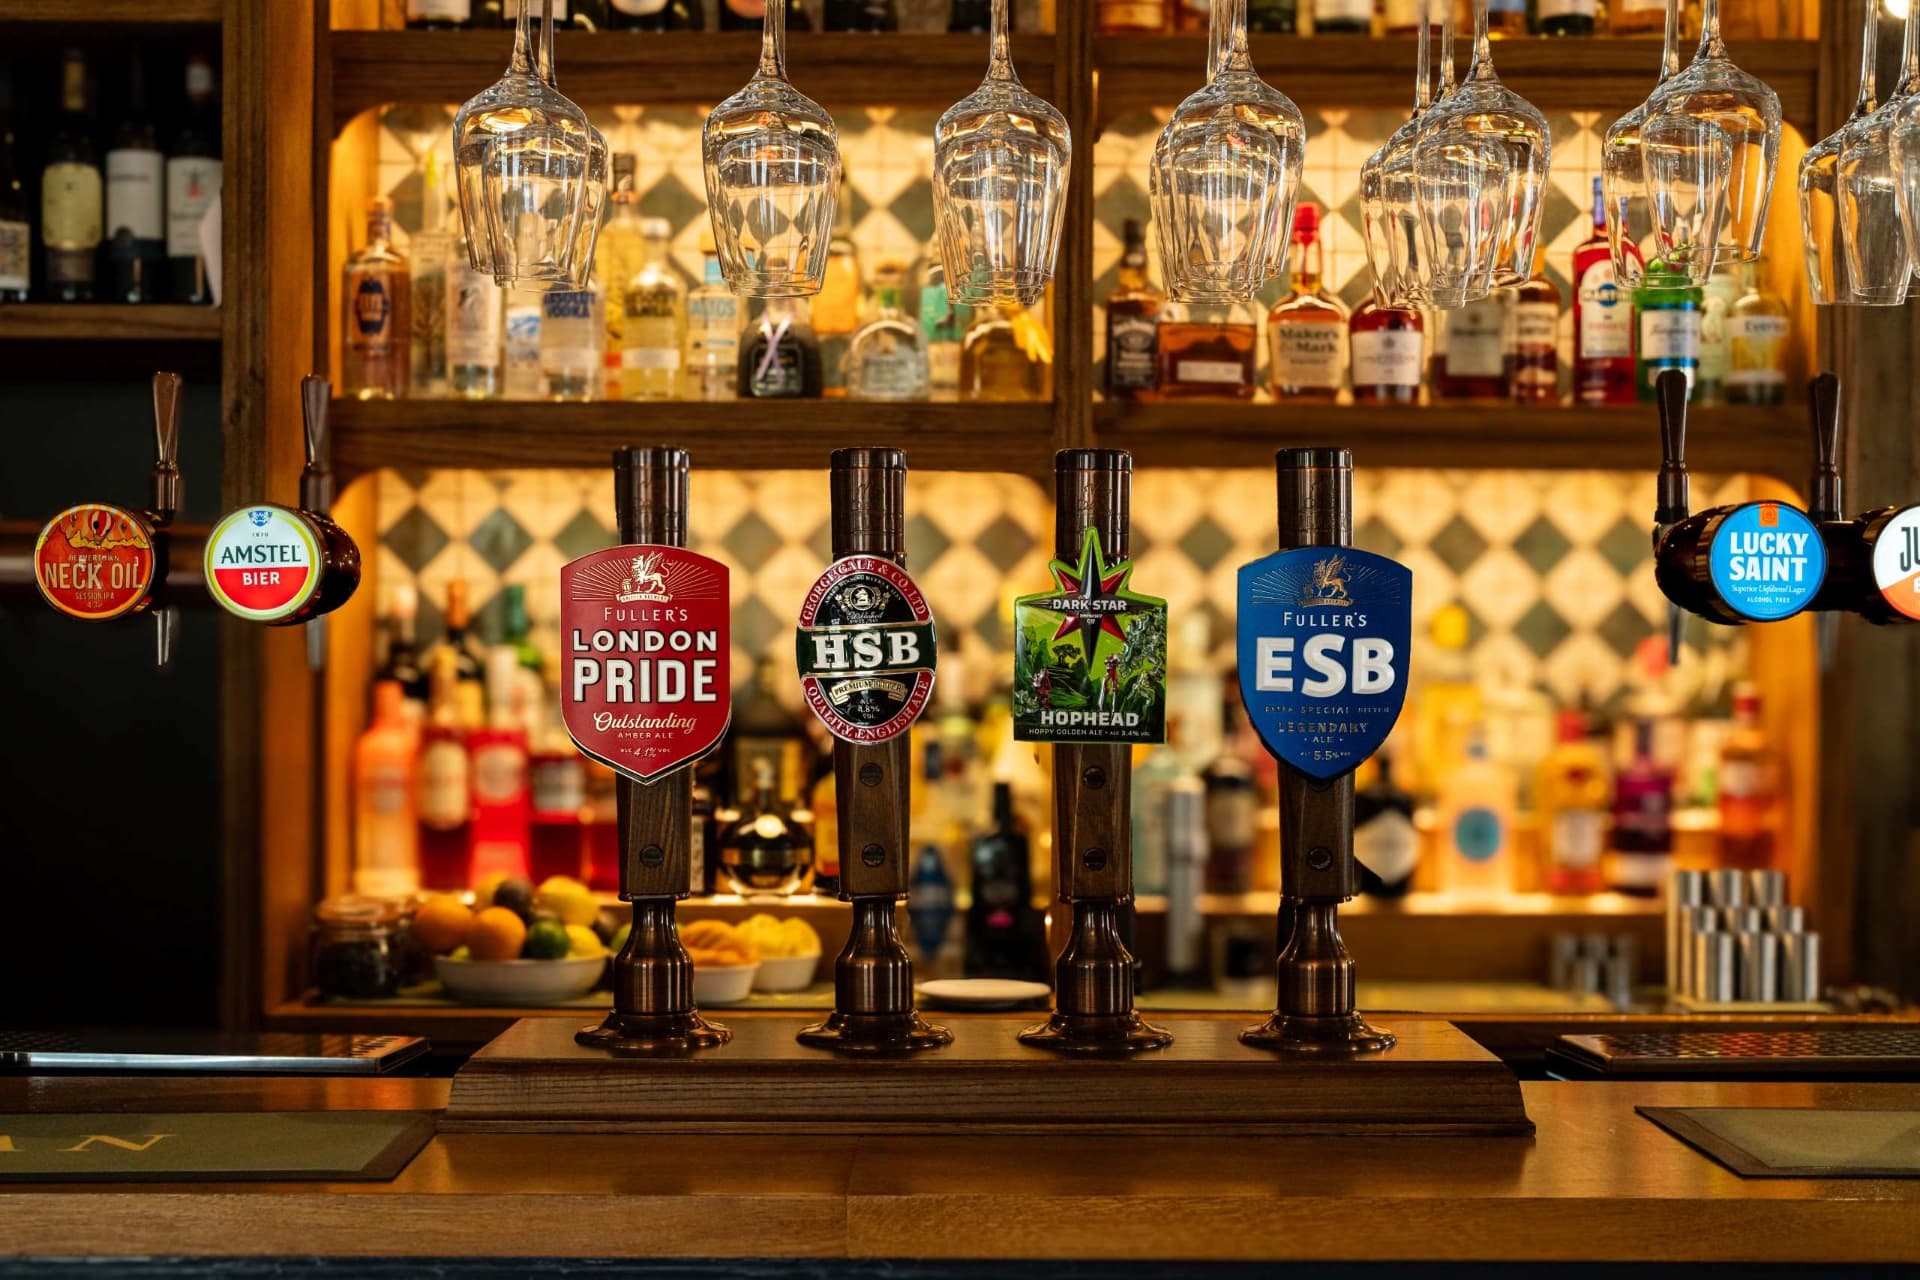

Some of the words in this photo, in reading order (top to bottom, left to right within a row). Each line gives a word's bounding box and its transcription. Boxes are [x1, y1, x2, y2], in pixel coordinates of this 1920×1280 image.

[221, 544, 302, 564] AMSTEL
[1730, 532, 1809, 555] LUCKY
[44, 562, 103, 590] NECK
[111, 562, 143, 589] OIL
[242, 571, 280, 586] BIER
[878, 565, 889, 575] &
[1729, 556, 1808, 582] SAINT
[1053, 600, 1089, 610] DARK
[1092, 600, 1127, 611] STAR
[572, 629, 718, 653] LONDON
[811, 631, 920, 669] HSB
[1256, 633, 1396, 698] ESB
[572, 658, 718, 703] PRIDE
[807, 686, 852, 736] QUALITY
[855, 708, 914, 740] ENGLISH
[912, 680, 929, 706] ALE
[1041, 711, 1139, 727] HOPHEAD
[593, 711, 697, 735] Outstanding
[1278, 722, 1368, 733] LEGENDARY
[1312, 735, 1334, 743] ALE
